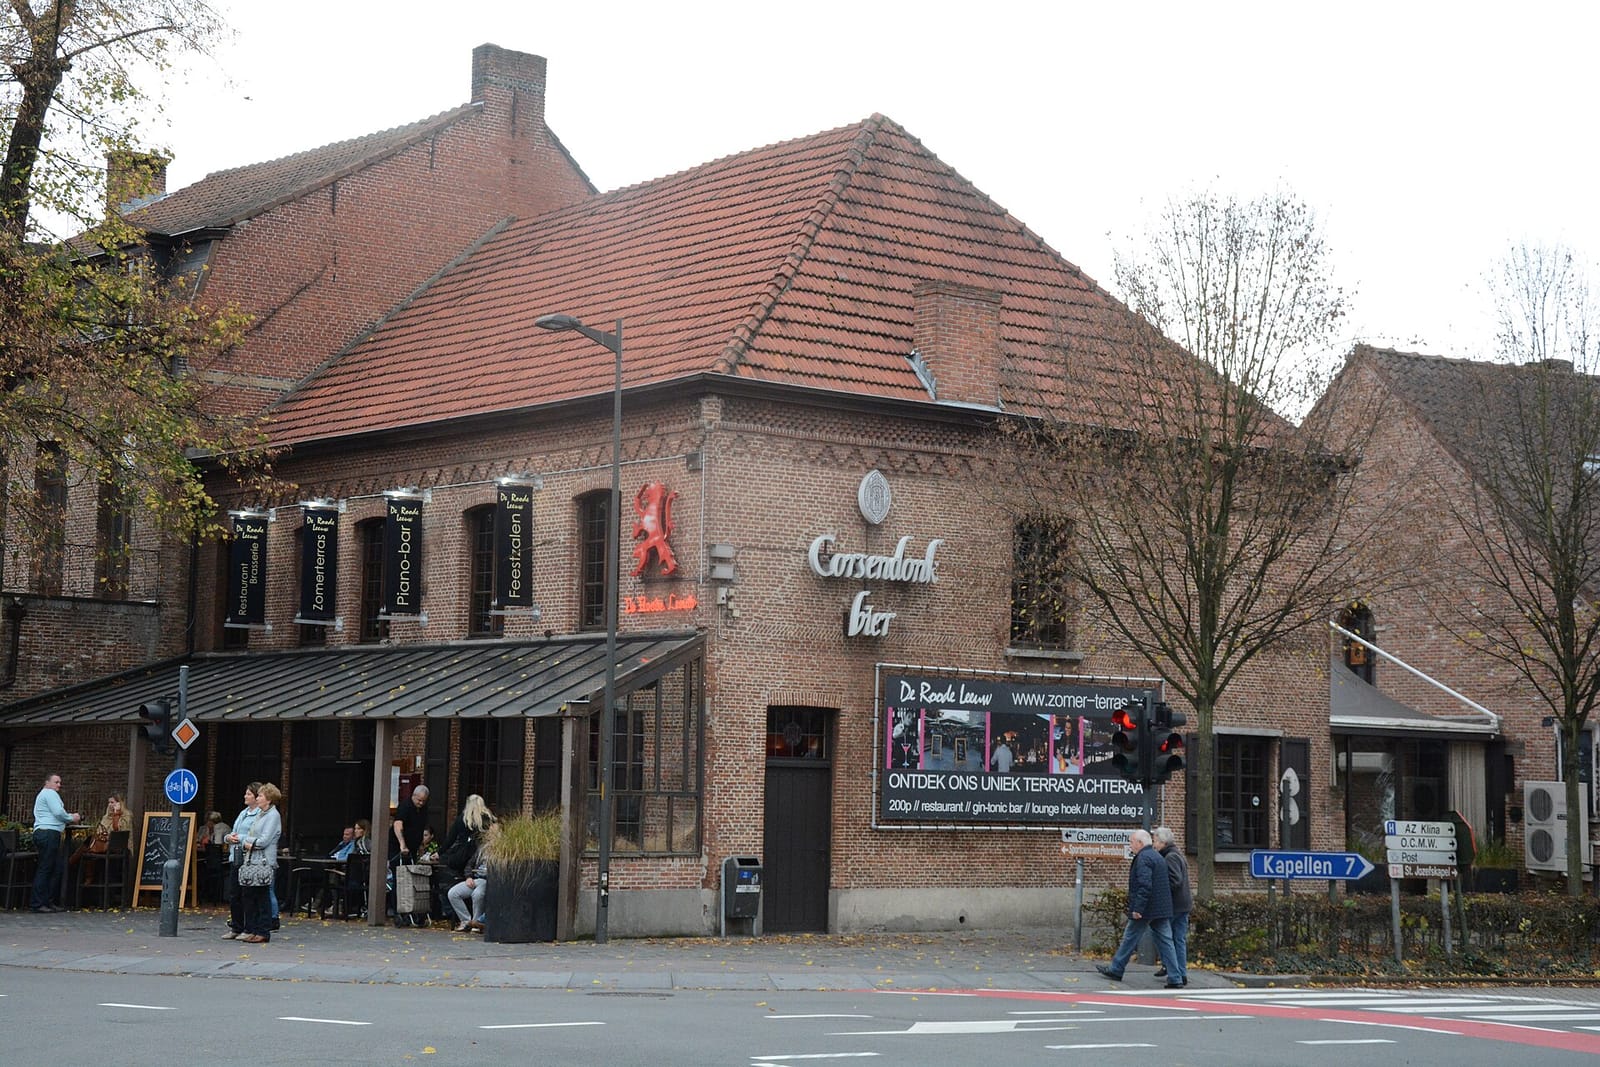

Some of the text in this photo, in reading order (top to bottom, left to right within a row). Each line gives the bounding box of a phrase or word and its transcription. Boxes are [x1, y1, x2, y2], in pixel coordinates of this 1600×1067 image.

[250, 542, 259, 584] Brasserie
[313, 534, 326, 611] Zomerterras
[397, 525, 412, 606] Piano-bar
[509, 513, 521, 598] Feestzalen
[809, 535, 944, 584] Corsendonk
[239, 563, 249, 616] Restaurant
[848, 591, 897, 636] bier
[900, 680, 992, 706] De Roode Leeuw
[889, 773, 1143, 794] ONTDEK ONS UNIEK TERRAS ACHTERAA
[889, 800, 911, 813] 200p
[922, 801, 963, 812] restaurant
[973, 801, 1007, 815] gin-tonic
[1009, 802, 1023, 813] bar
[1032, 803, 1059, 816] lounge
[1062, 803, 1081, 814] hoek
[1090, 804, 1107, 814] heel
[1109, 804, 1119, 815] de
[1121, 805, 1136, 817] dag
[1400, 838, 1437, 848] O.C.M.W.
[1405, 824, 1417, 833] AZ
[1421, 824, 1440, 834] Klina
[1264, 856, 1355, 878] Kapellen 7
[1402, 852, 1417, 862] Post
